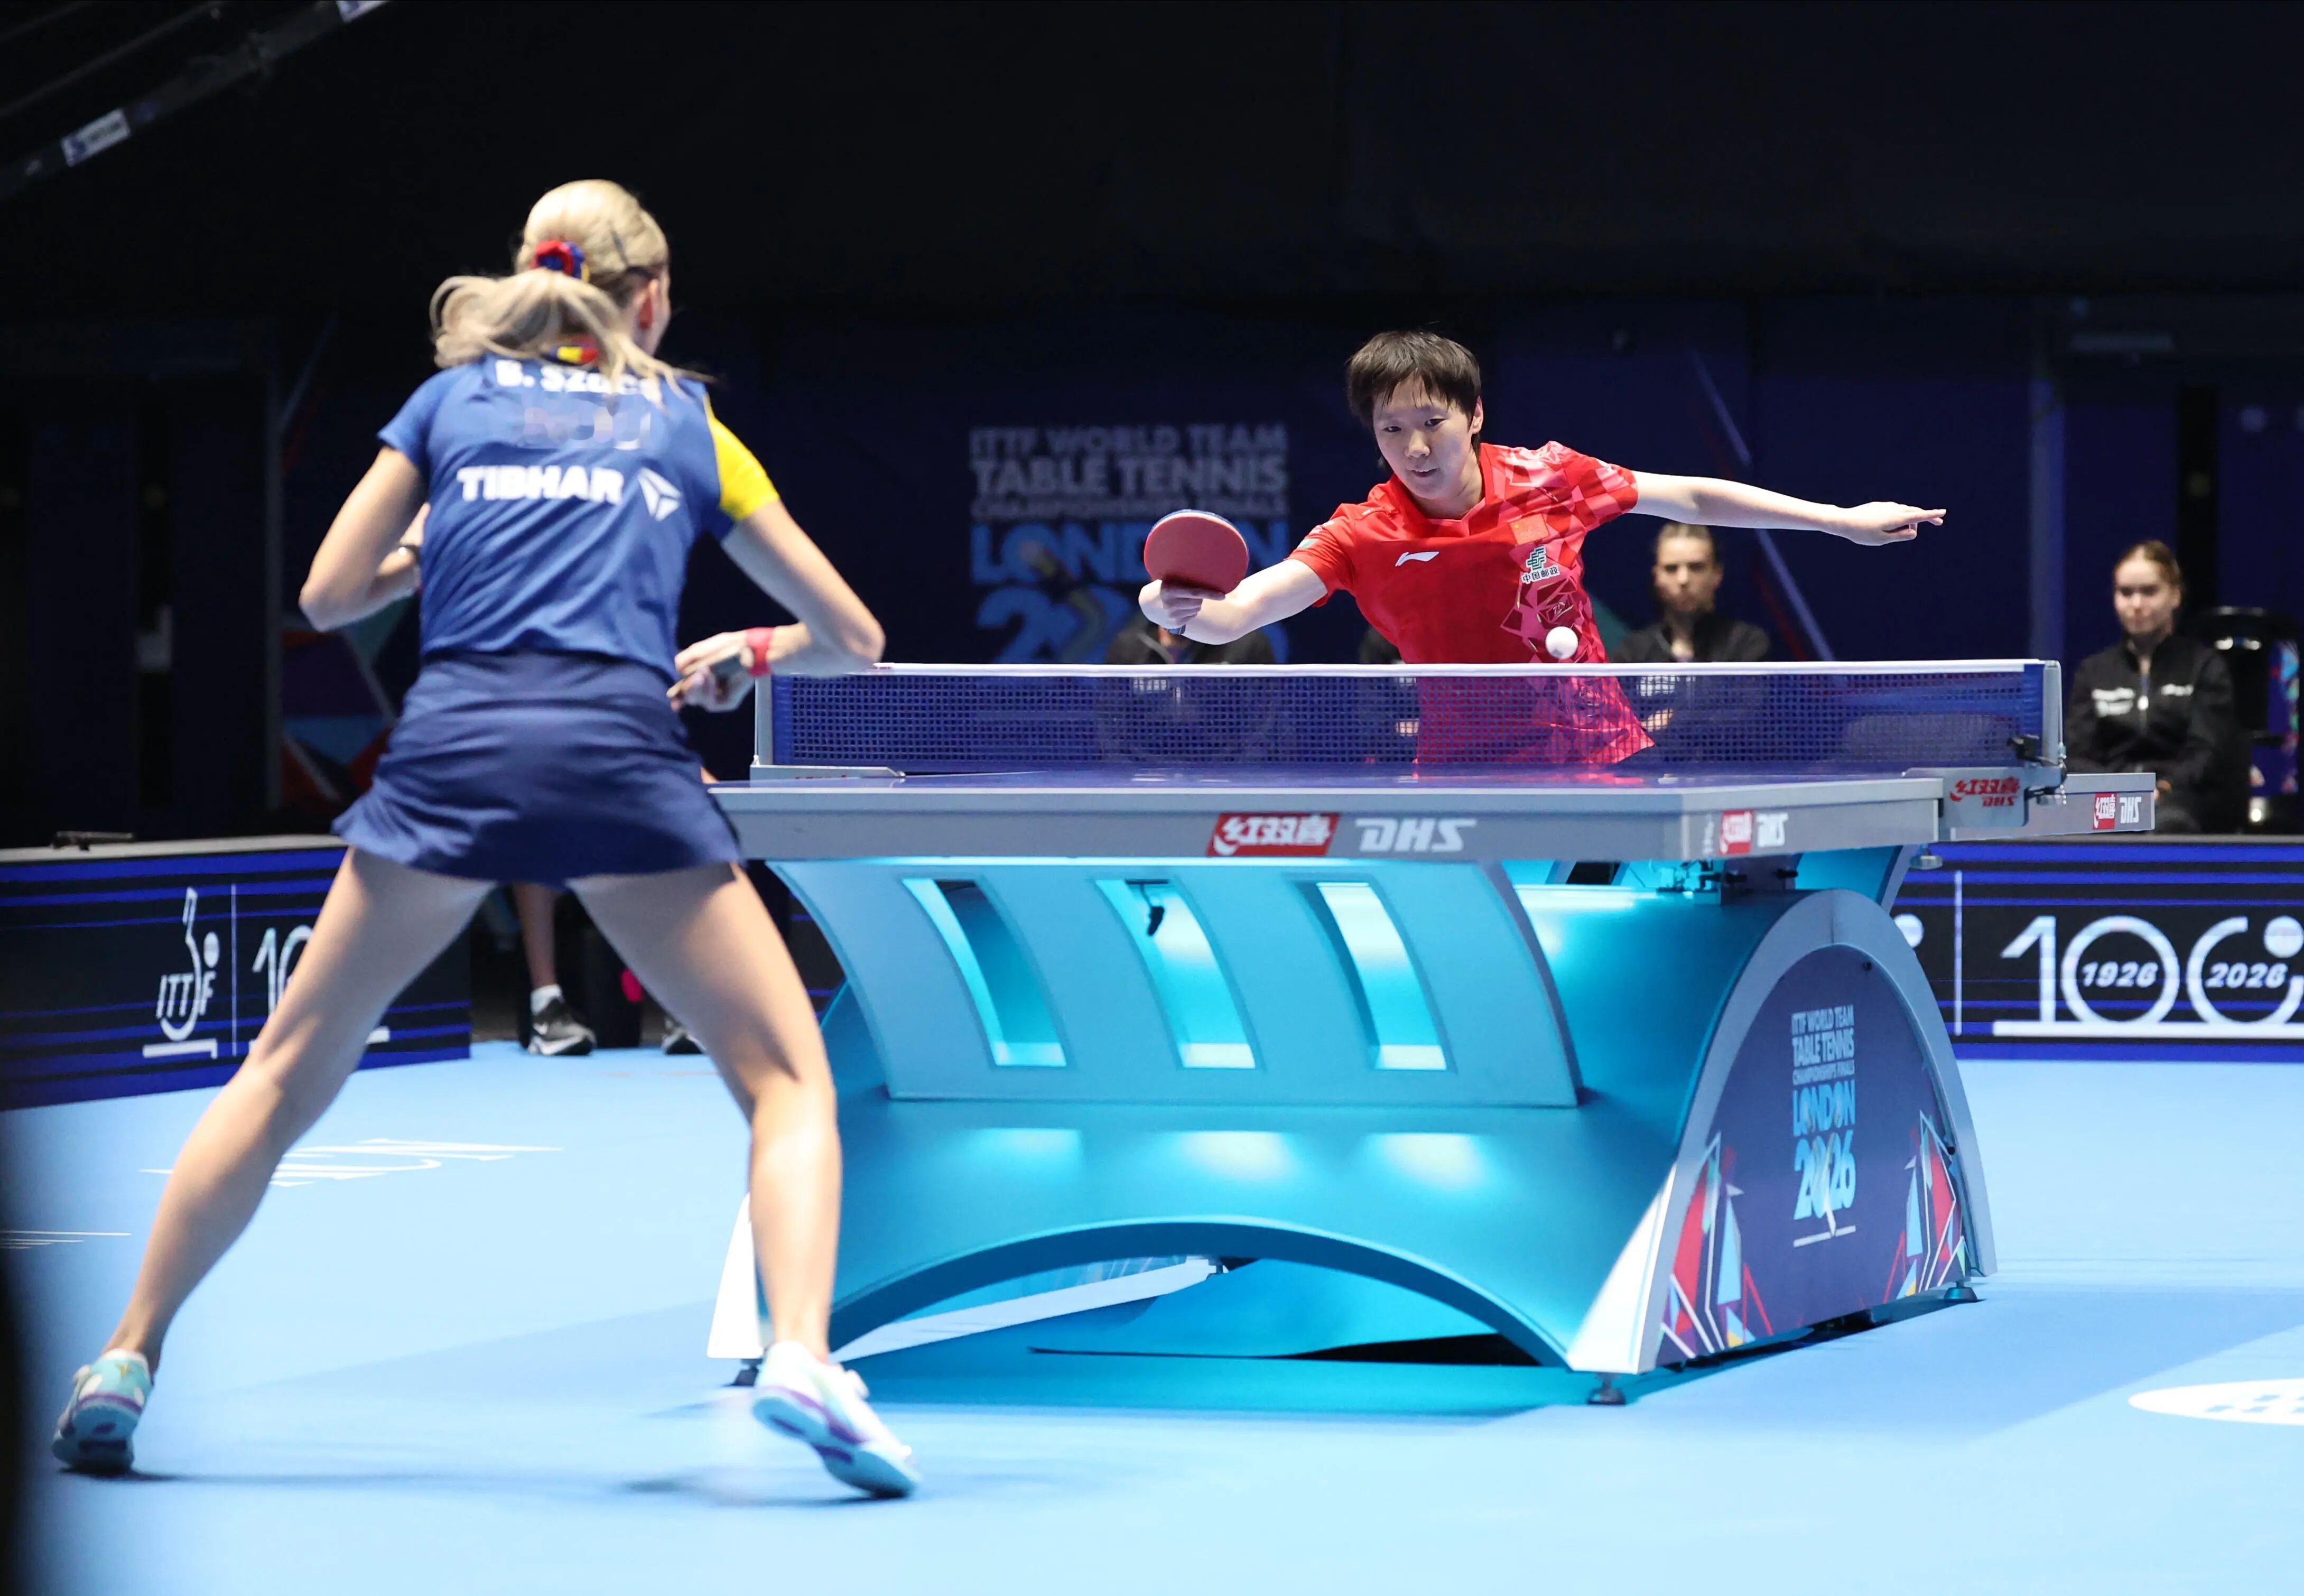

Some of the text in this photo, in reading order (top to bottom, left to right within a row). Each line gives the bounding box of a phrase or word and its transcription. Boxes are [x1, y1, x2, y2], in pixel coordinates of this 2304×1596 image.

[456, 466, 625, 504] TIBHAR
[1522, 566, 1558, 582] 中国邮政
[2119, 796, 2142, 824] DHS
[1354, 818, 1476, 852] DHS
[2082, 961, 2288, 989] 1926 2026
[1793, 1079, 1856, 1136] LONDON
[1793, 1129, 1856, 1220] 2026
